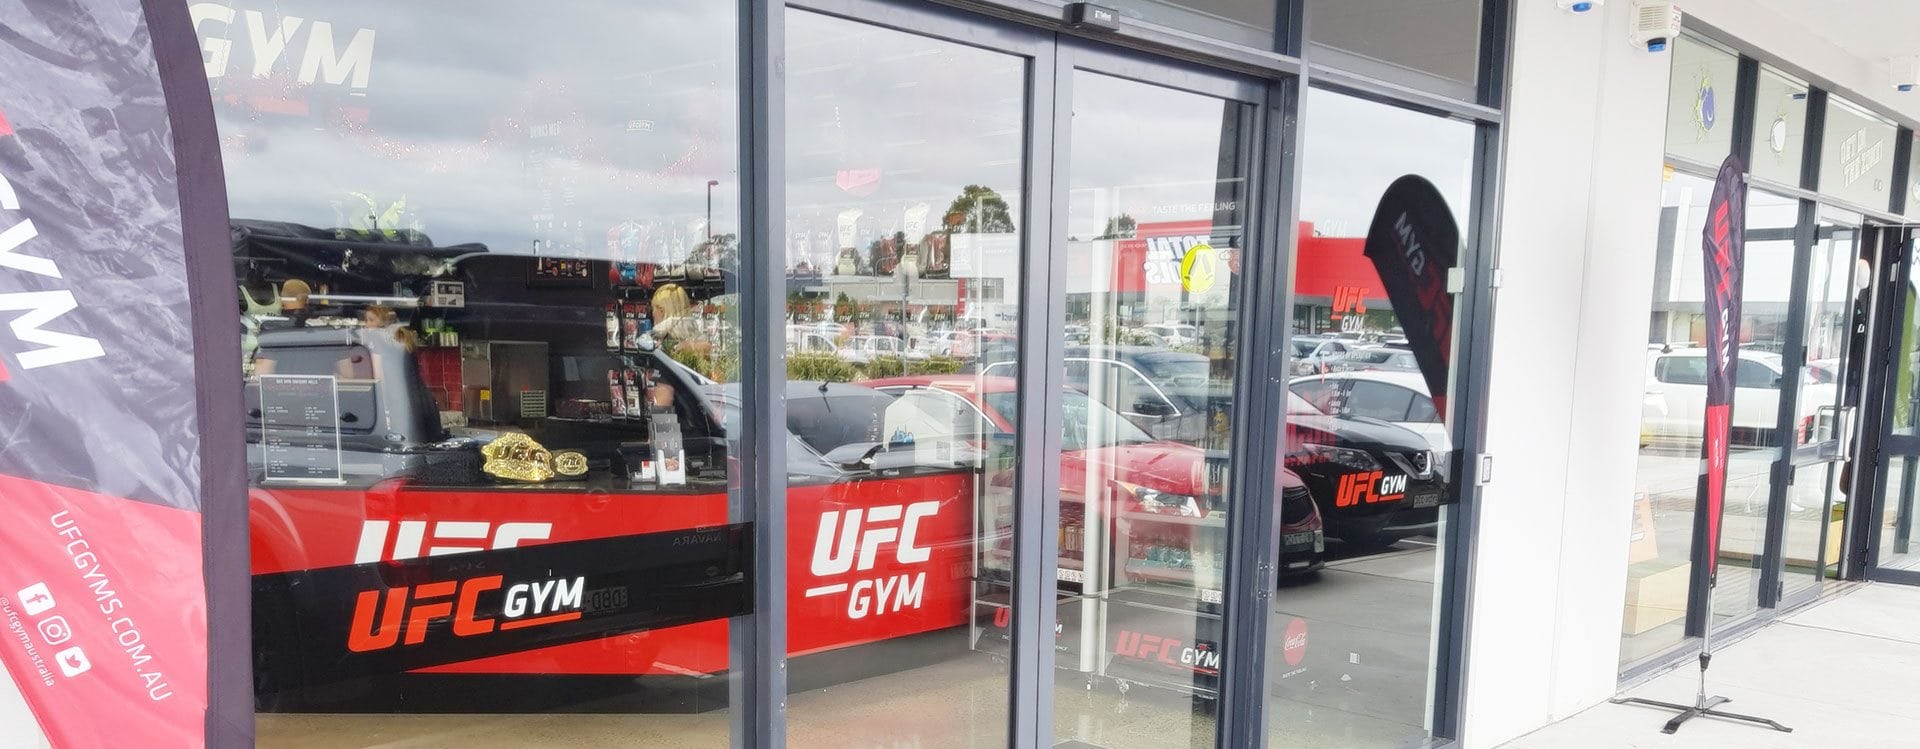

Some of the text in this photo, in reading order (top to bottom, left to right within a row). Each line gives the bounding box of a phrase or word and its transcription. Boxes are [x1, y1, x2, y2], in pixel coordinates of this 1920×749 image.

[189, 3, 376, 96] GYM
[1181, 204, 1197, 213] THE
[1199, 201, 1237, 212] FEELING
[0, 171, 106, 371] YM
[1331, 286, 1370, 314] UFC
[1341, 314, 1365, 331] GYM
[1336, 471, 1383, 507] UFC
[1381, 475, 1407, 495] GYM
[811, 500, 940, 577] UFC
[51, 510, 173, 701] UFCGYMS.COM.AU
[348, 575, 585, 653] UFC GYM
[848, 573, 926, 620] GYM
[0, 596, 55, 687] @ufcgymaustralia
[1115, 630, 1220, 669] UFC GYM
